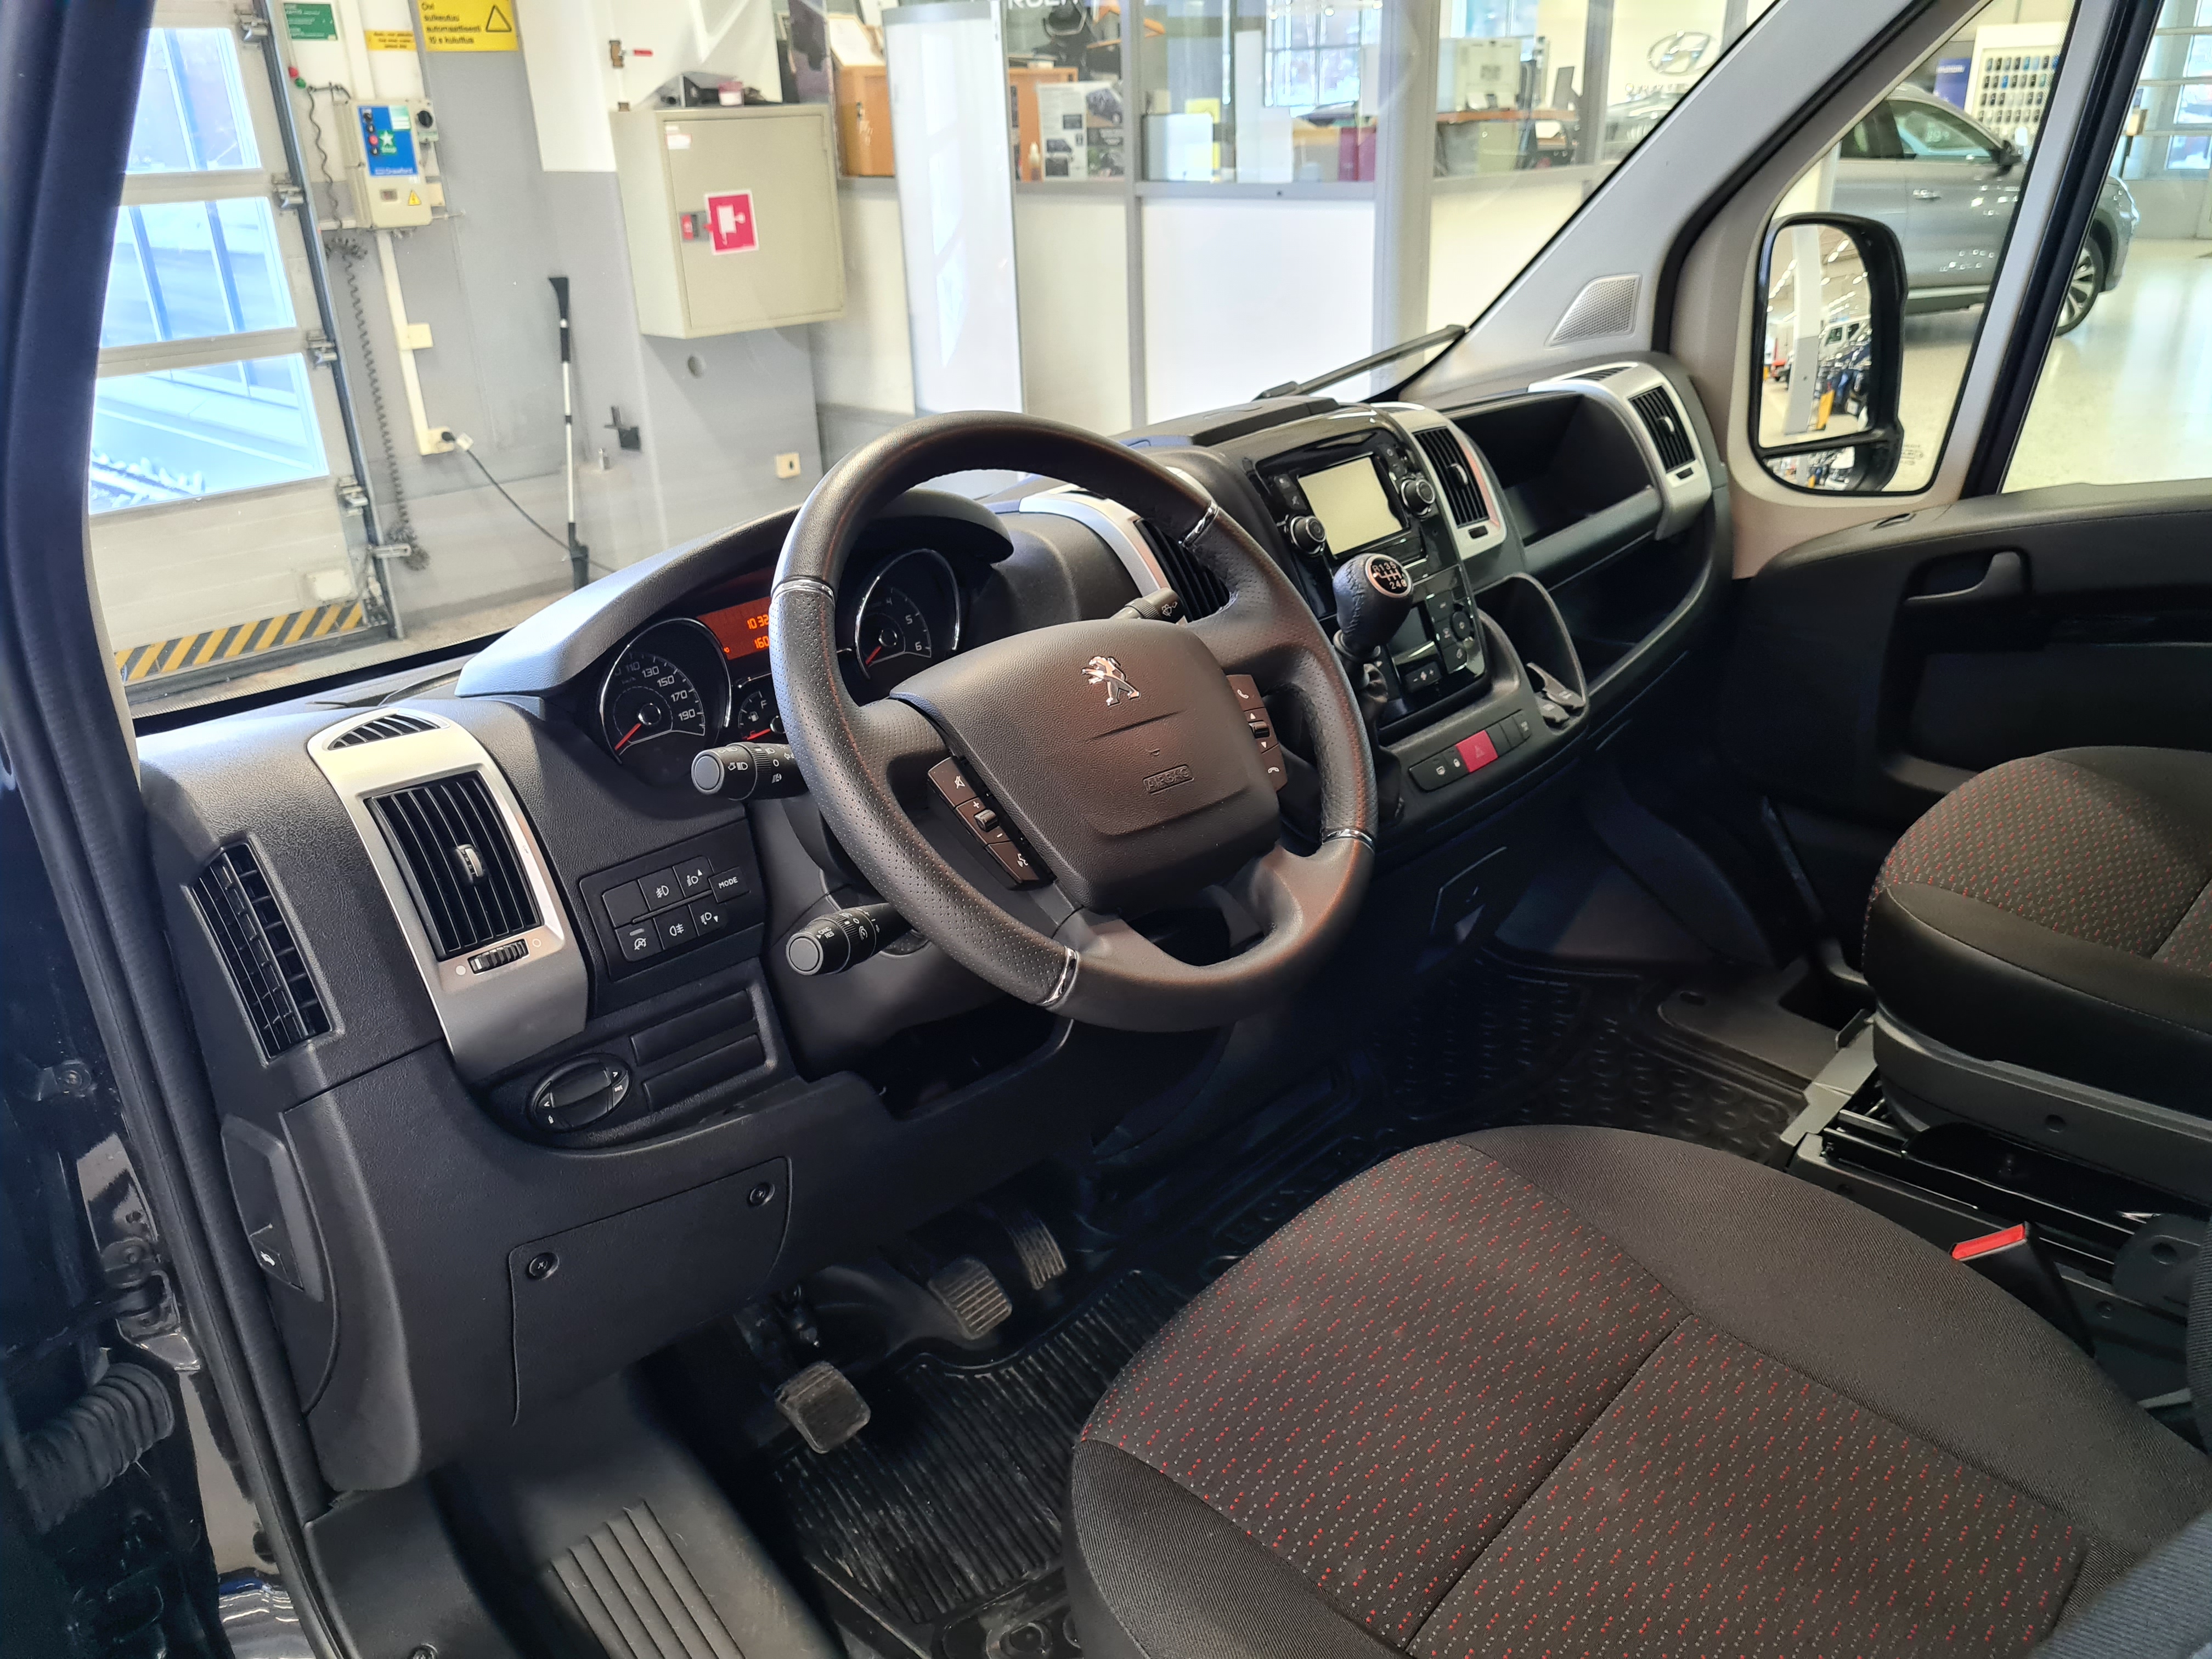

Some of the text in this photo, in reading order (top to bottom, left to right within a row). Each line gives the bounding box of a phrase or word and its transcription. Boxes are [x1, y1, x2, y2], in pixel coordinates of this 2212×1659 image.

[905, 614, 913, 625] 5
[915, 641, 922, 651] 6
[642, 666, 659, 678] 130
[657, 675, 675, 687] 150
[670, 690, 688, 702] 170
[760, 699, 768, 709] F
[678, 708, 696, 721] 190
[718, 876, 738, 889] MODE
